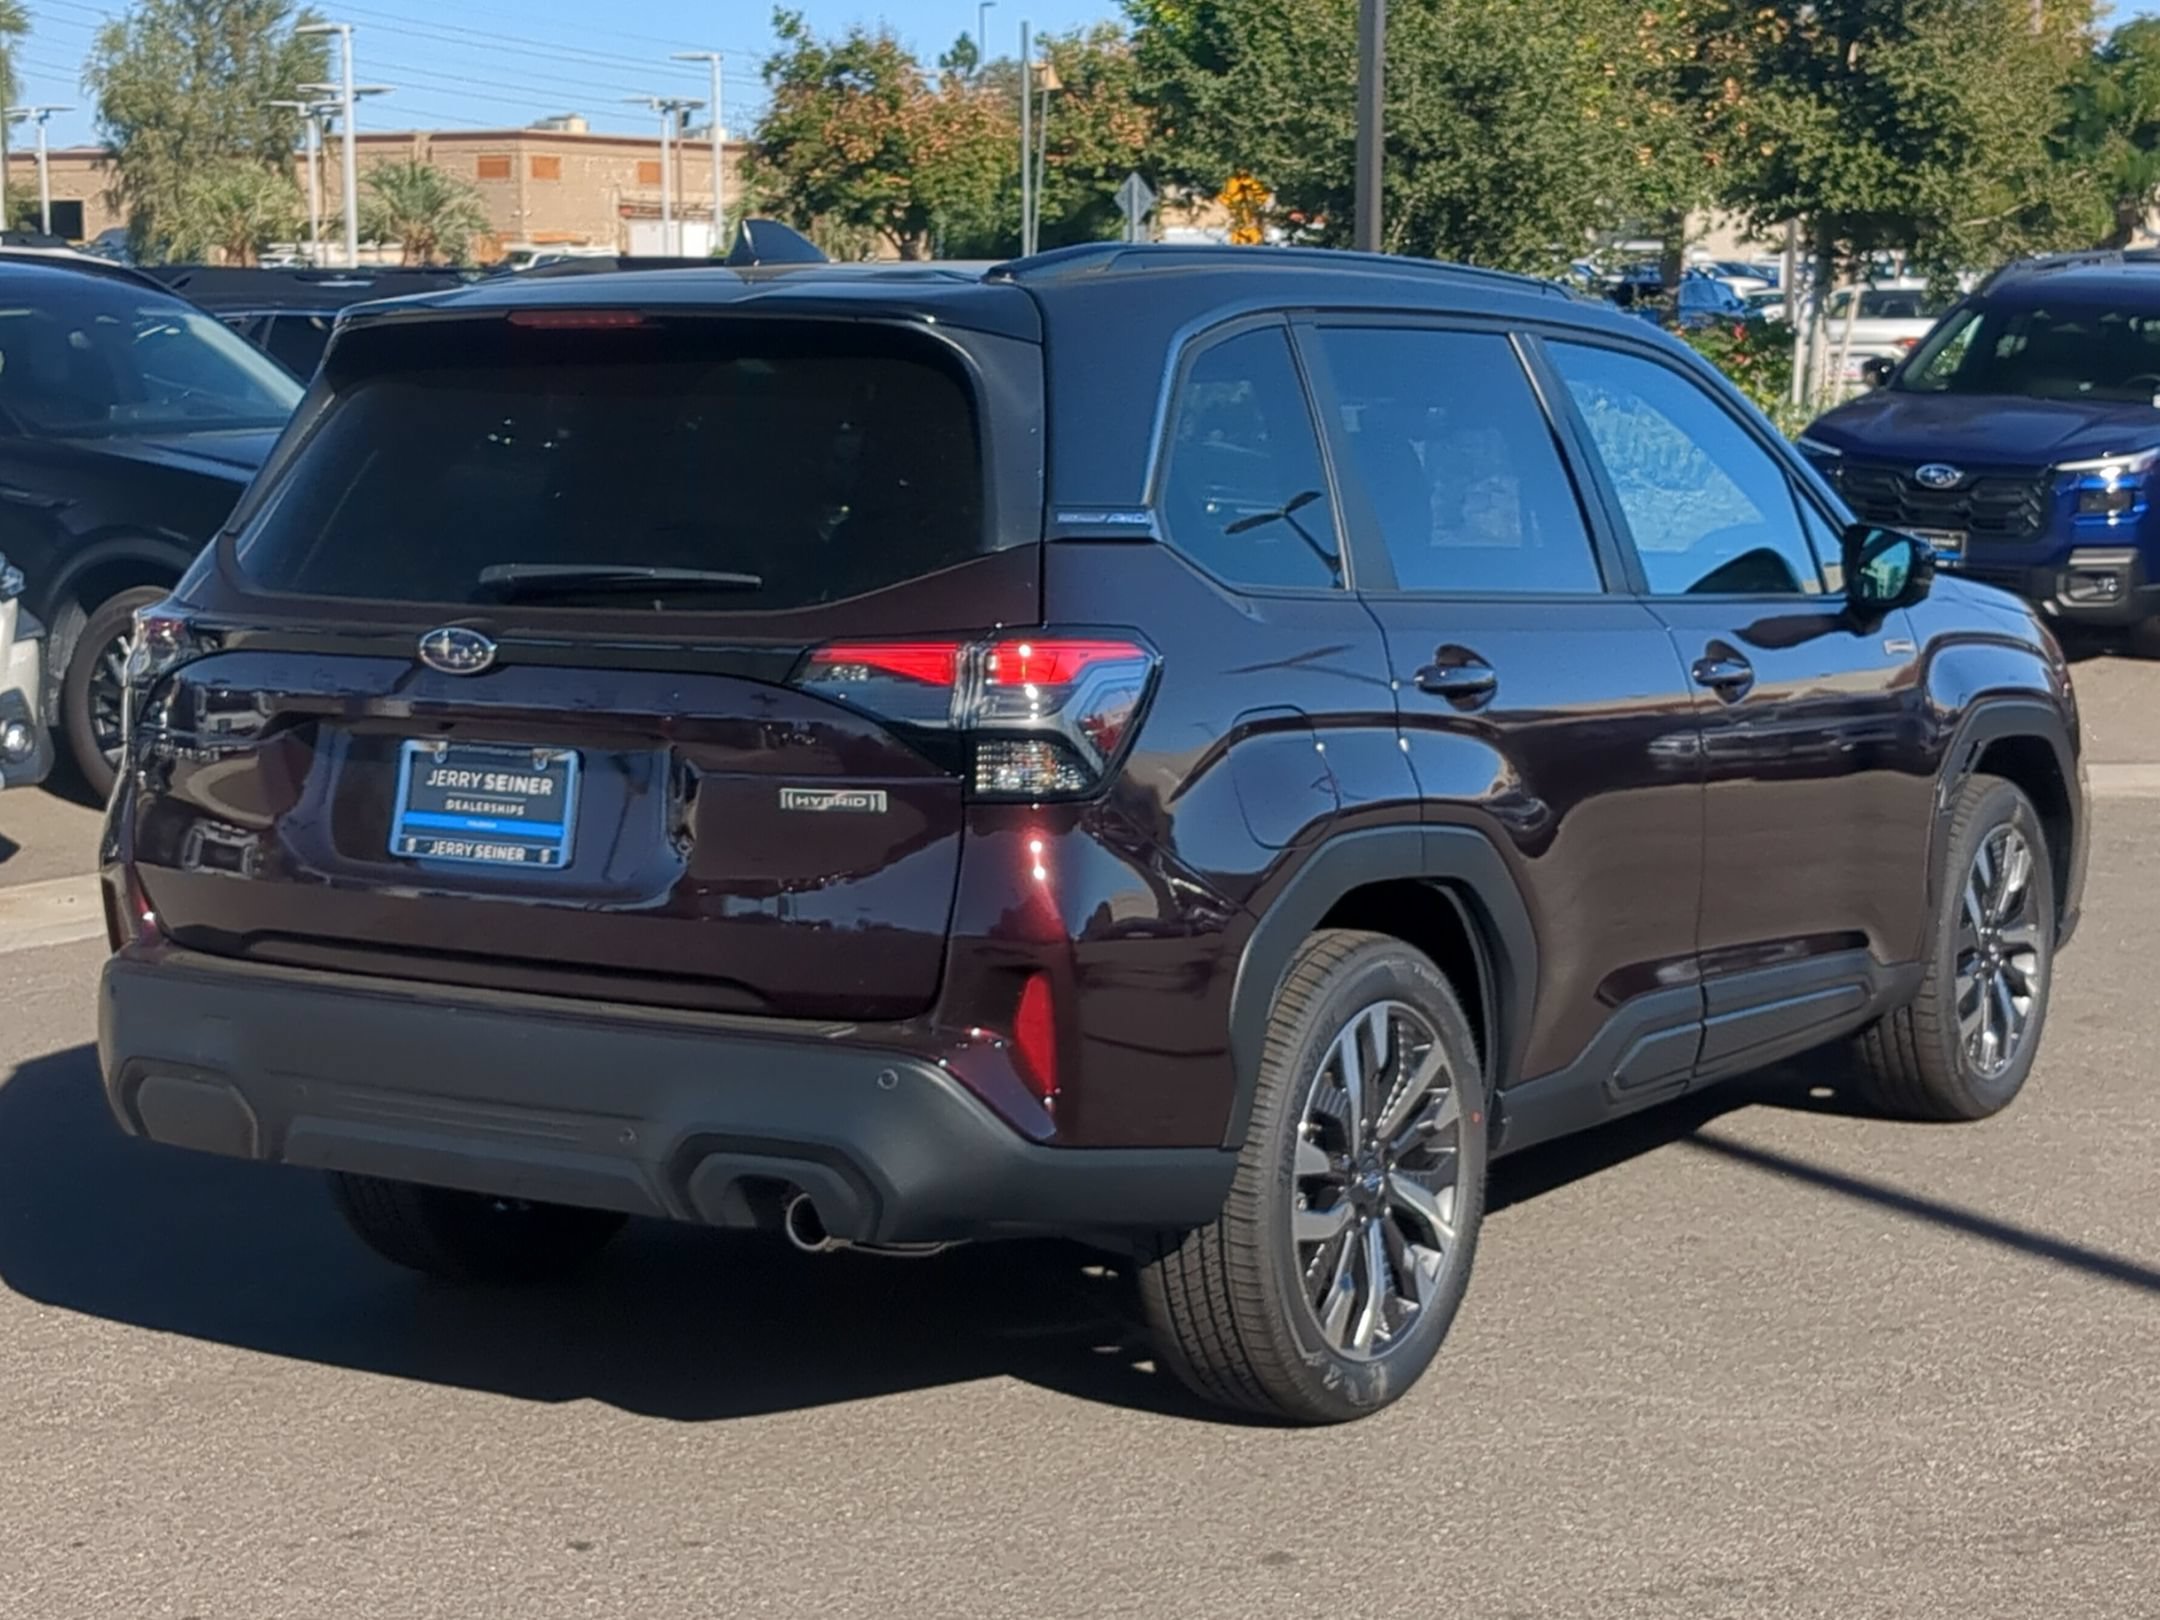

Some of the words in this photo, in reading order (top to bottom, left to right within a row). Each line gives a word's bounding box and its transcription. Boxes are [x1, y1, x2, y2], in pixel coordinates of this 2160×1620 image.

[427, 770, 482, 788] JERRY
[484, 773, 553, 795] SEINER
[445, 800, 525, 816] DEALERSHIPS
[795, 796, 867, 807] HYBRID
[430, 841, 472, 856] JERRY
[474, 844, 526, 861] SEINER
